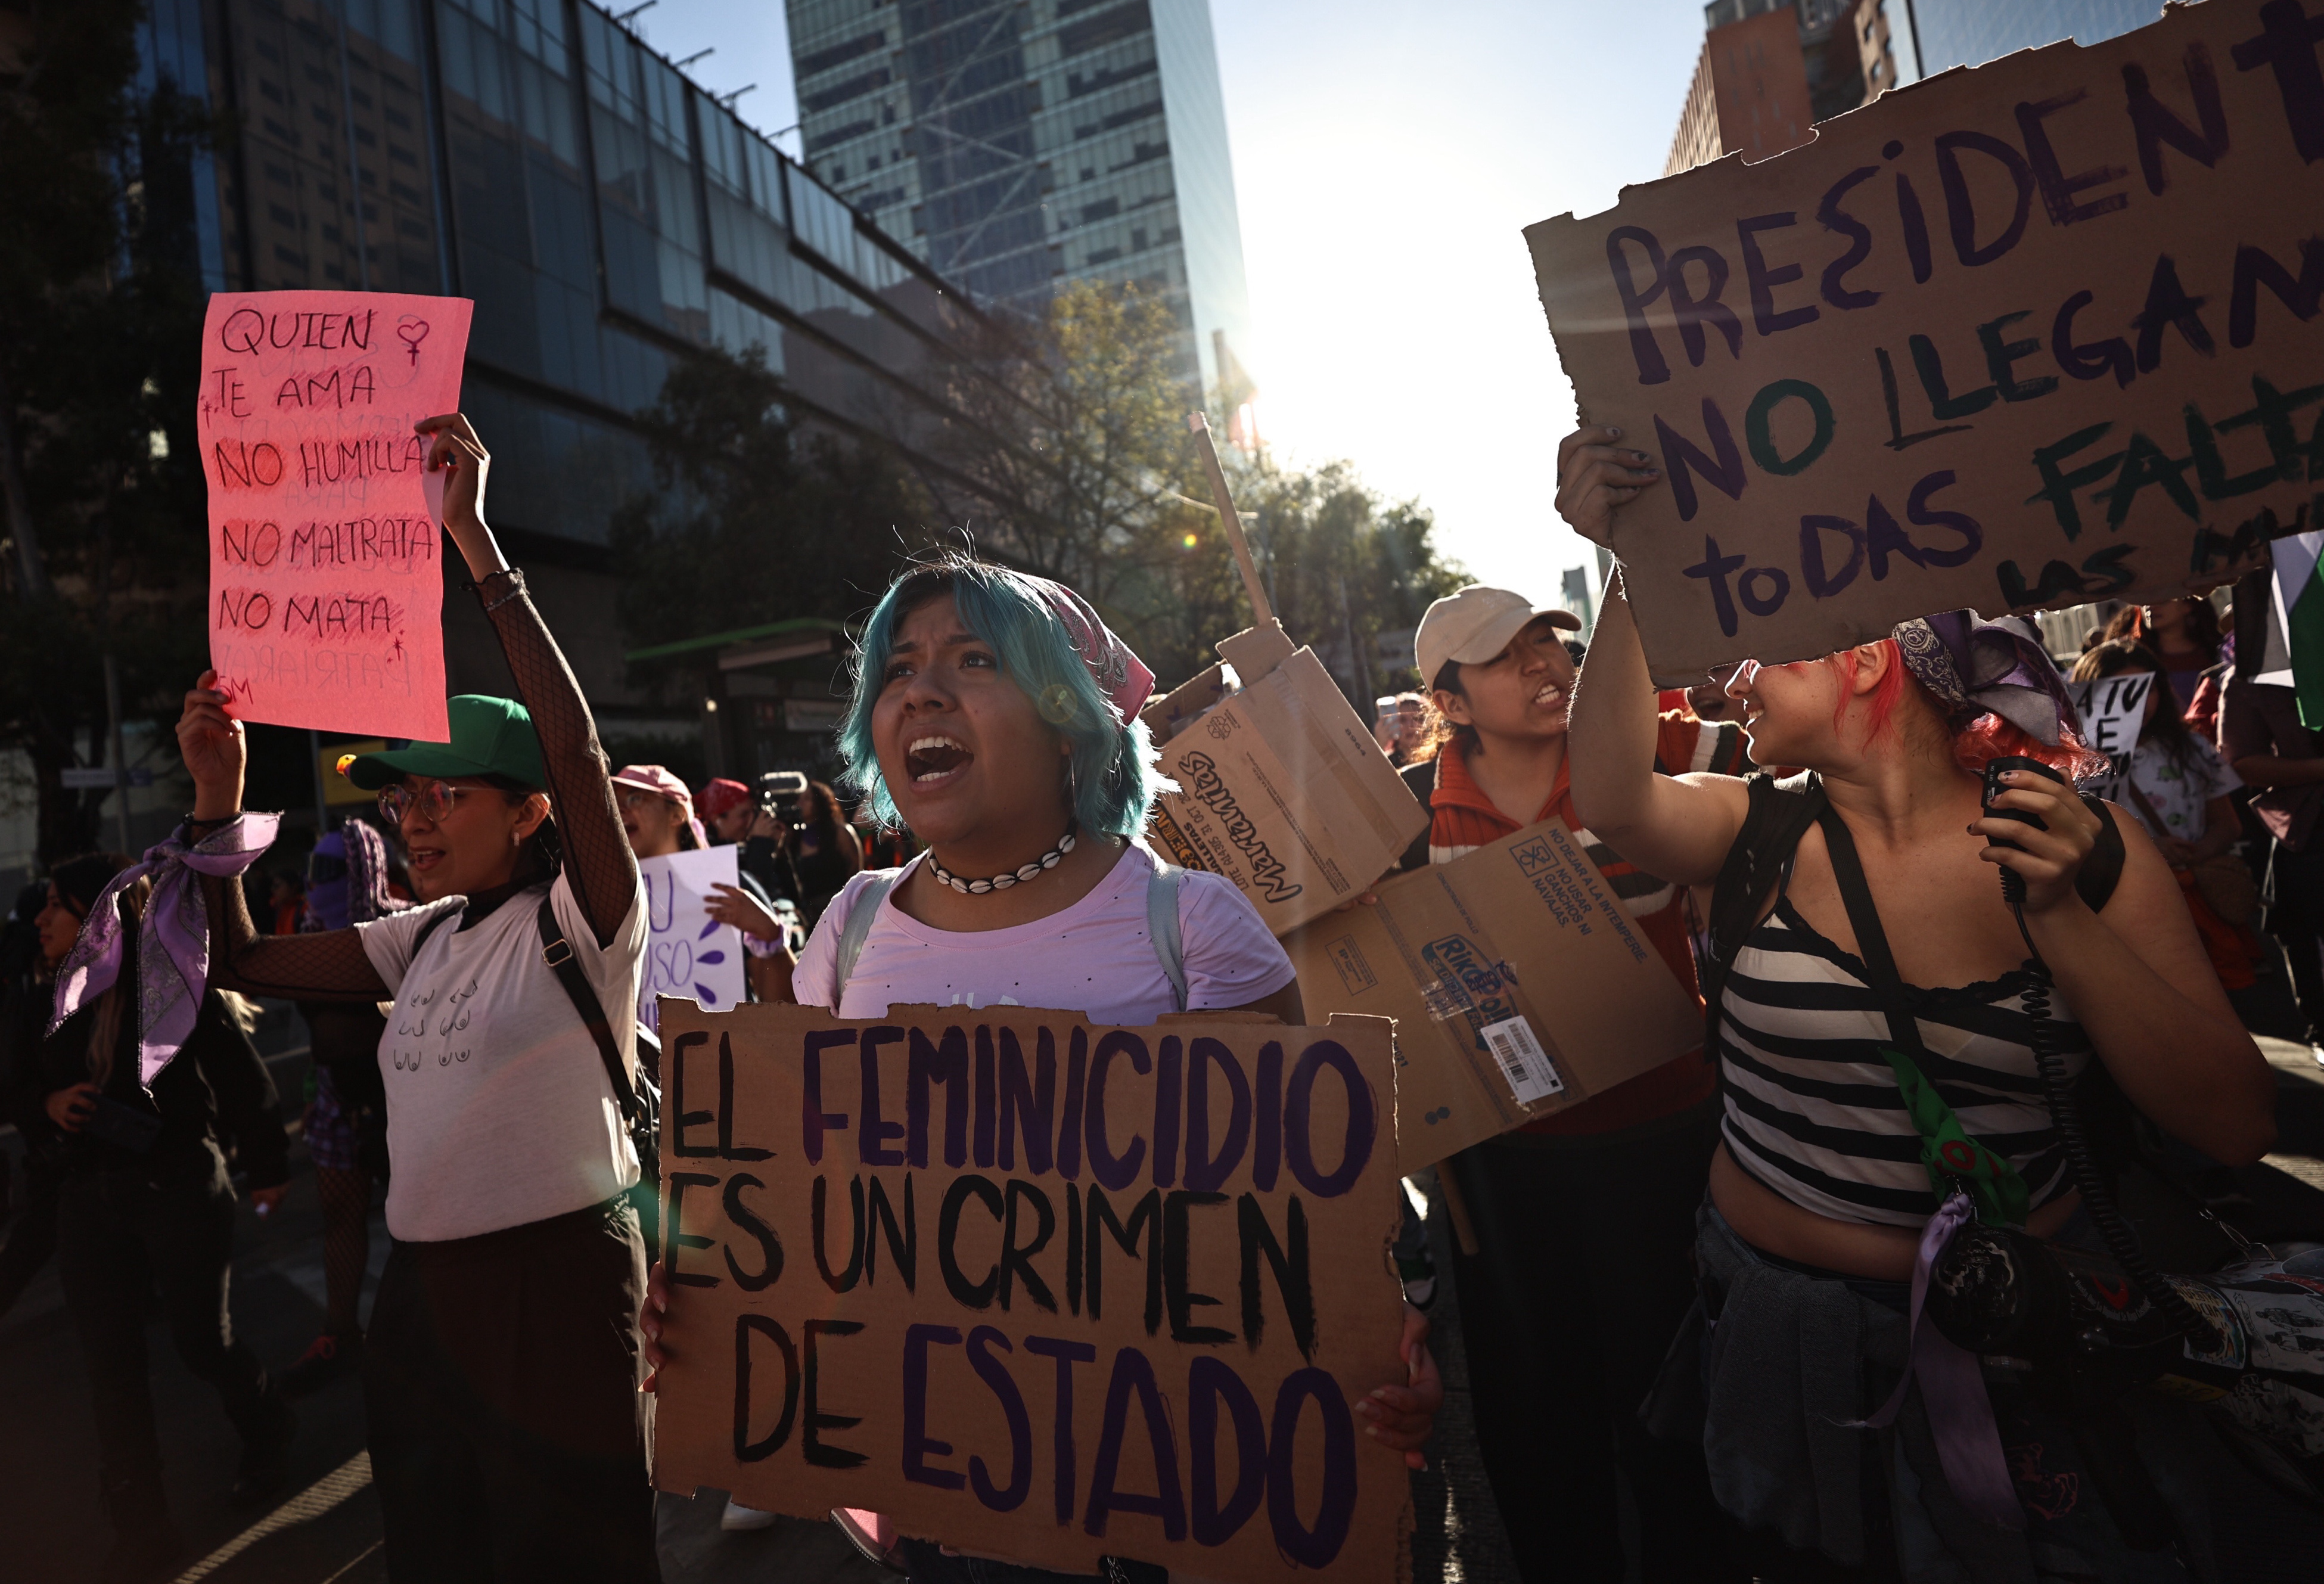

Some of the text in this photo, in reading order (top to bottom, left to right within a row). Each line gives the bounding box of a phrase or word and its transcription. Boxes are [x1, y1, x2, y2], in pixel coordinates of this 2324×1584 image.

[221, 308, 372, 355] QUIEN
[212, 365, 376, 417] TE AMA
[215, 435, 423, 487] NO HUMILLA
[1654, 378, 1835, 522] NO
[222, 517, 434, 567] NO MALTRATA
[219, 589, 392, 638] NO MATA
[1344, 728, 1366, 757] 8964
[1178, 751, 1303, 903] Marianitas
[1182, 820, 1225, 878] GALLETAS
[1531, 876, 1571, 928] NAVAJAS.
[1543, 871, 1592, 936] GANCHOS NI
[1548, 827, 1648, 965] NO DEJAR A LA INTEMPERIE.
[1555, 866, 1592, 914] NO USAR
[673, 1030, 777, 1161] EL
[803, 1024, 1377, 1198] FEMINICIDIO
[665, 1172, 1317, 1367] ES UN CRIMEN
[733, 1313, 1358, 1570] DE ESTADO
